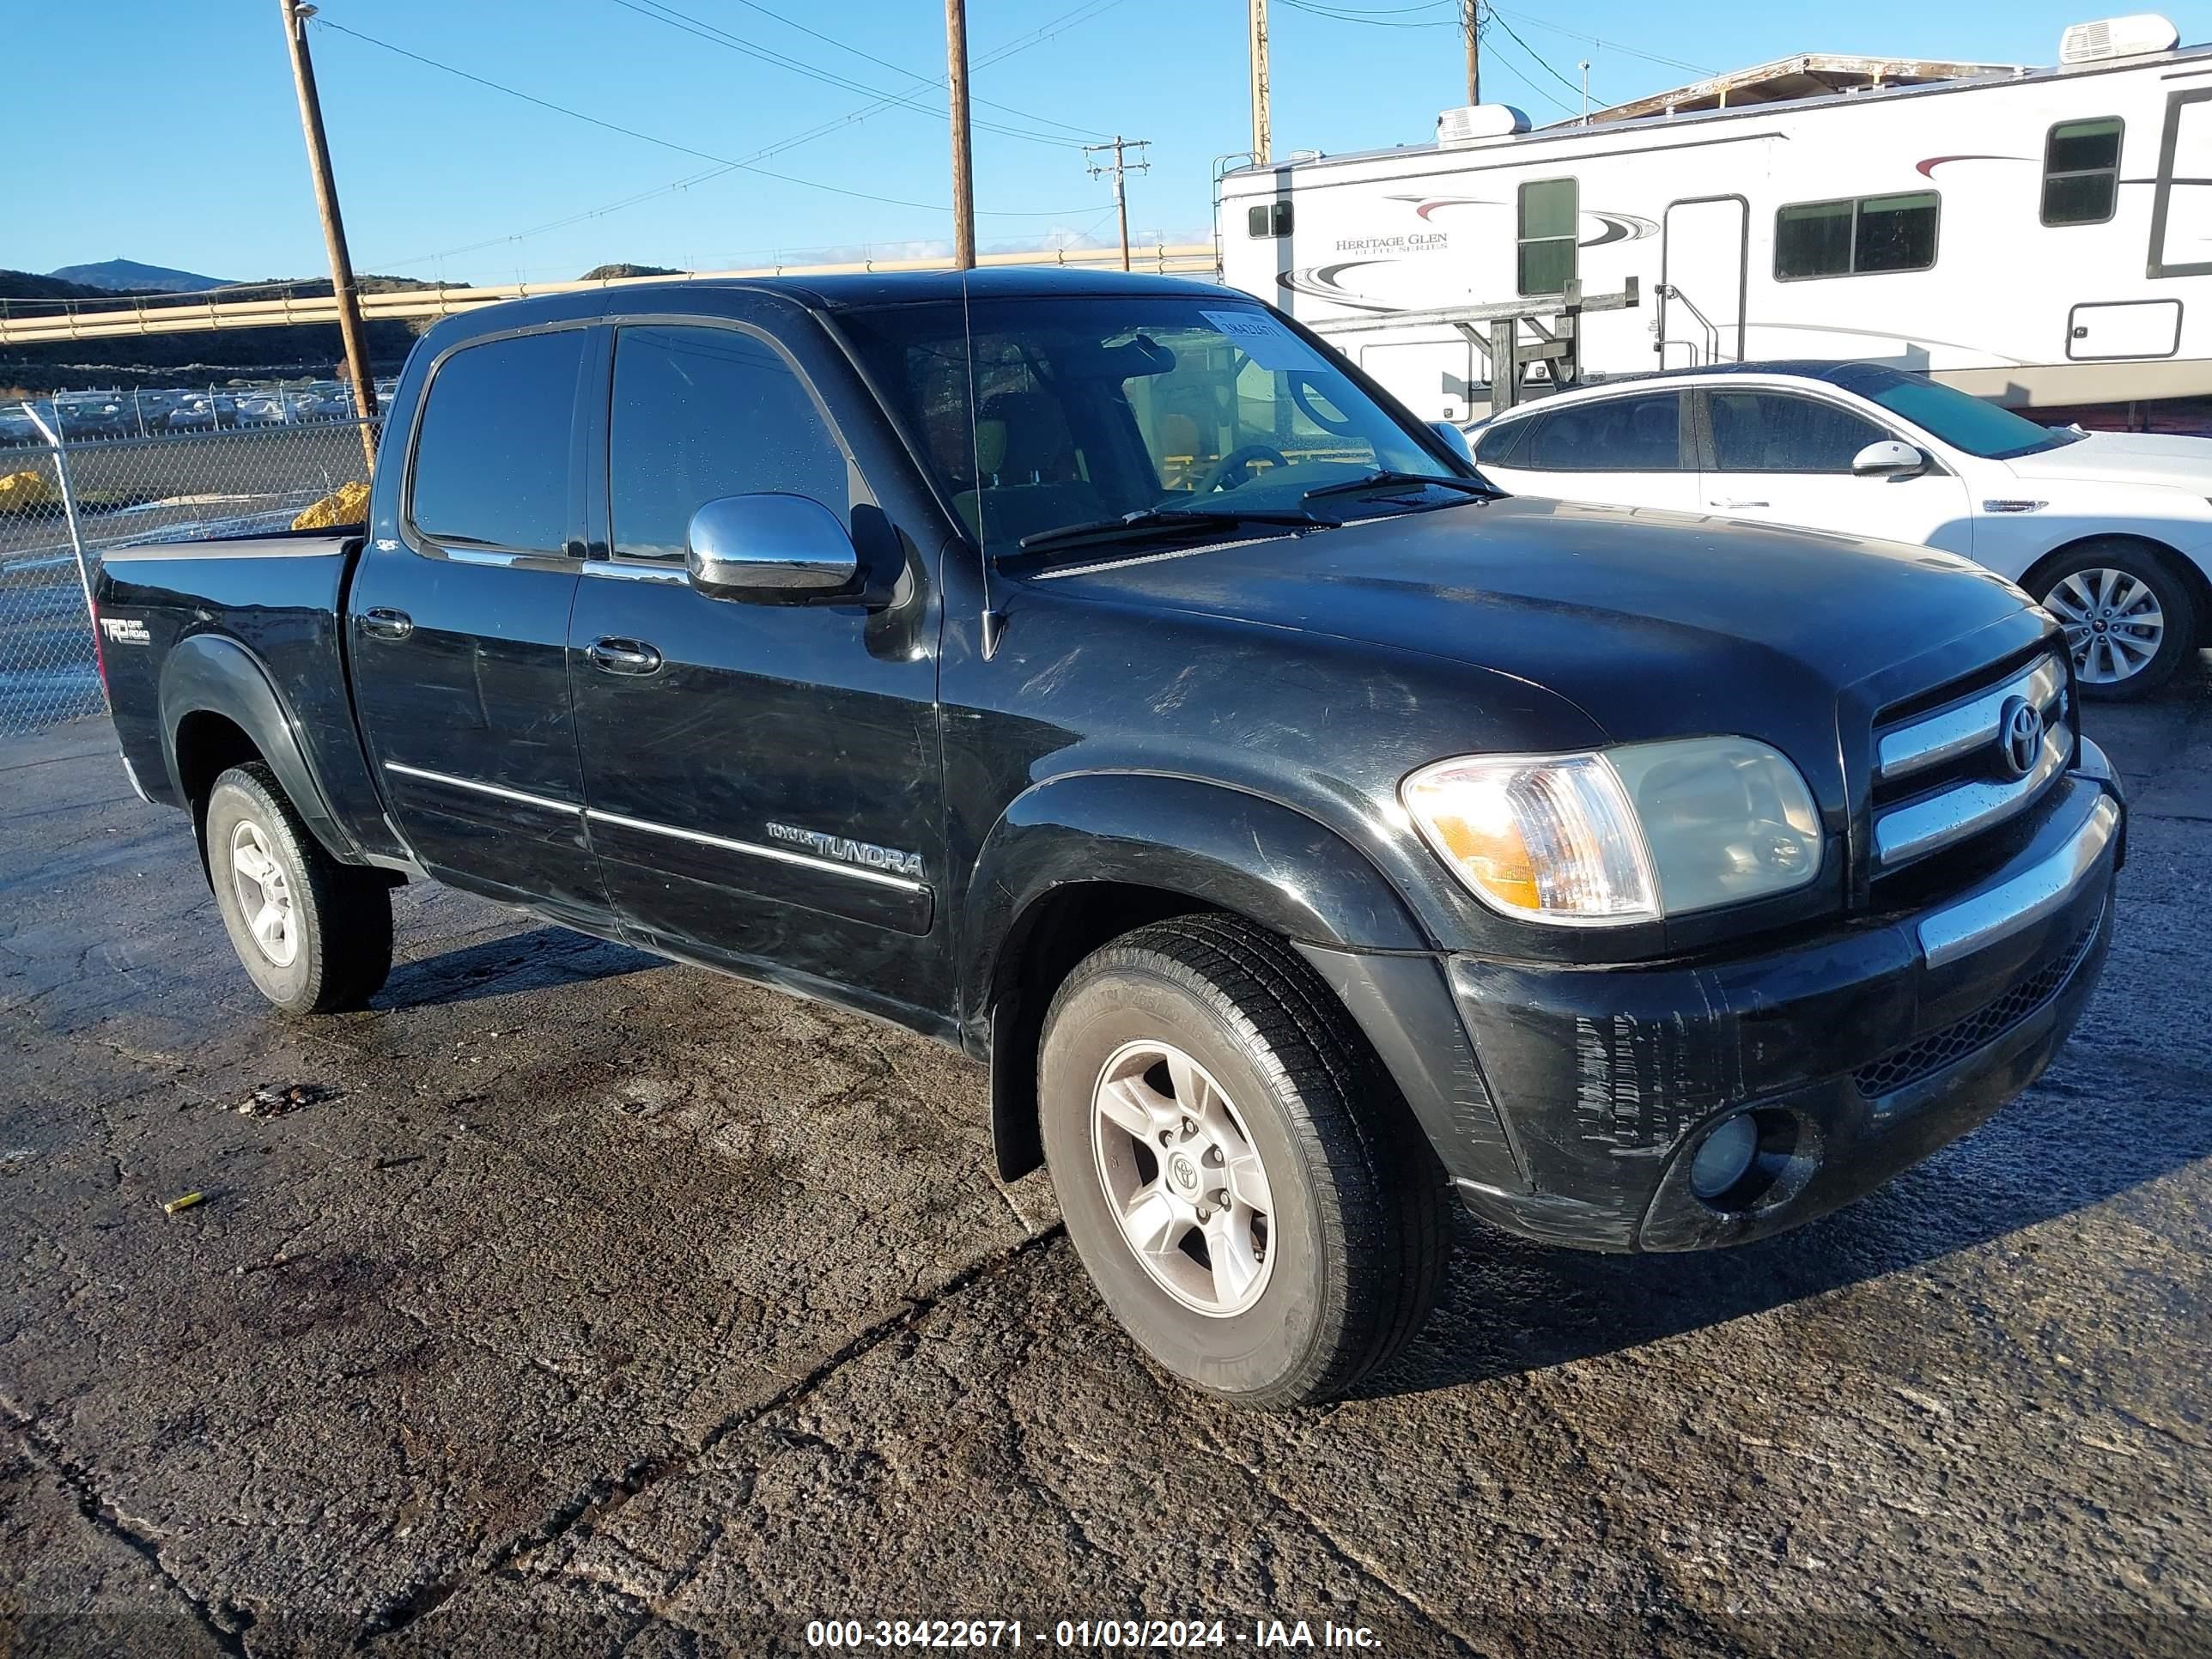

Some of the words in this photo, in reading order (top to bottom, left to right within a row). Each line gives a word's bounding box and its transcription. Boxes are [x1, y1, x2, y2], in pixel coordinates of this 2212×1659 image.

[1336, 237, 1404, 251] HERITAGE
[1407, 233, 1448, 245] GLEN
[100, 618, 129, 643] TRD
[129, 629, 150, 640] ROAD
[813, 833, 928, 879] TUNDRA
